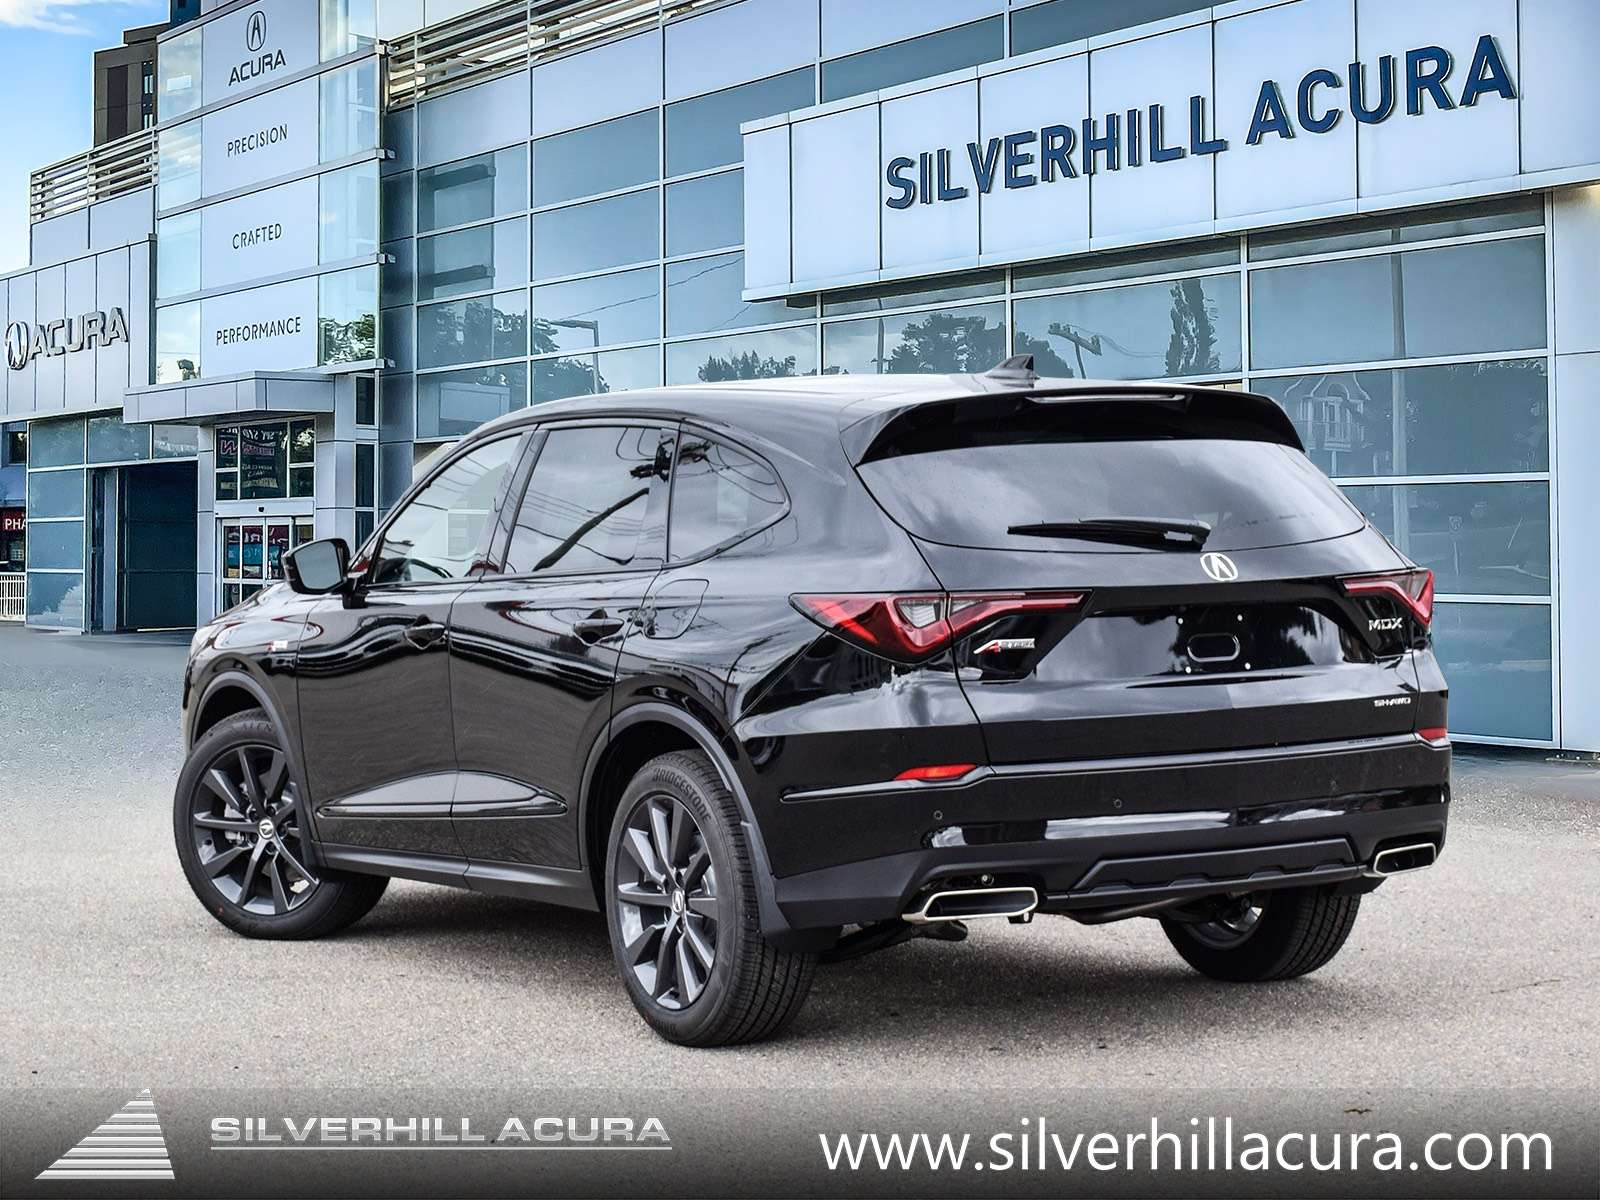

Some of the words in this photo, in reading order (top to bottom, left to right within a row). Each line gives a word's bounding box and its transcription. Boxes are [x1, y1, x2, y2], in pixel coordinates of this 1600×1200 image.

[228, 50, 286, 86] ACURA
[886, 96, 1226, 209] SILVERHILL
[1247, 35, 1517, 145] ACURA
[228, 125, 288, 157] PRECISION
[232, 224, 282, 249] CRAFTED
[28, 307, 129, 361] ACURA
[216, 318, 301, 346] PERFORMANCE
[1368, 618, 1402, 631] MDX
